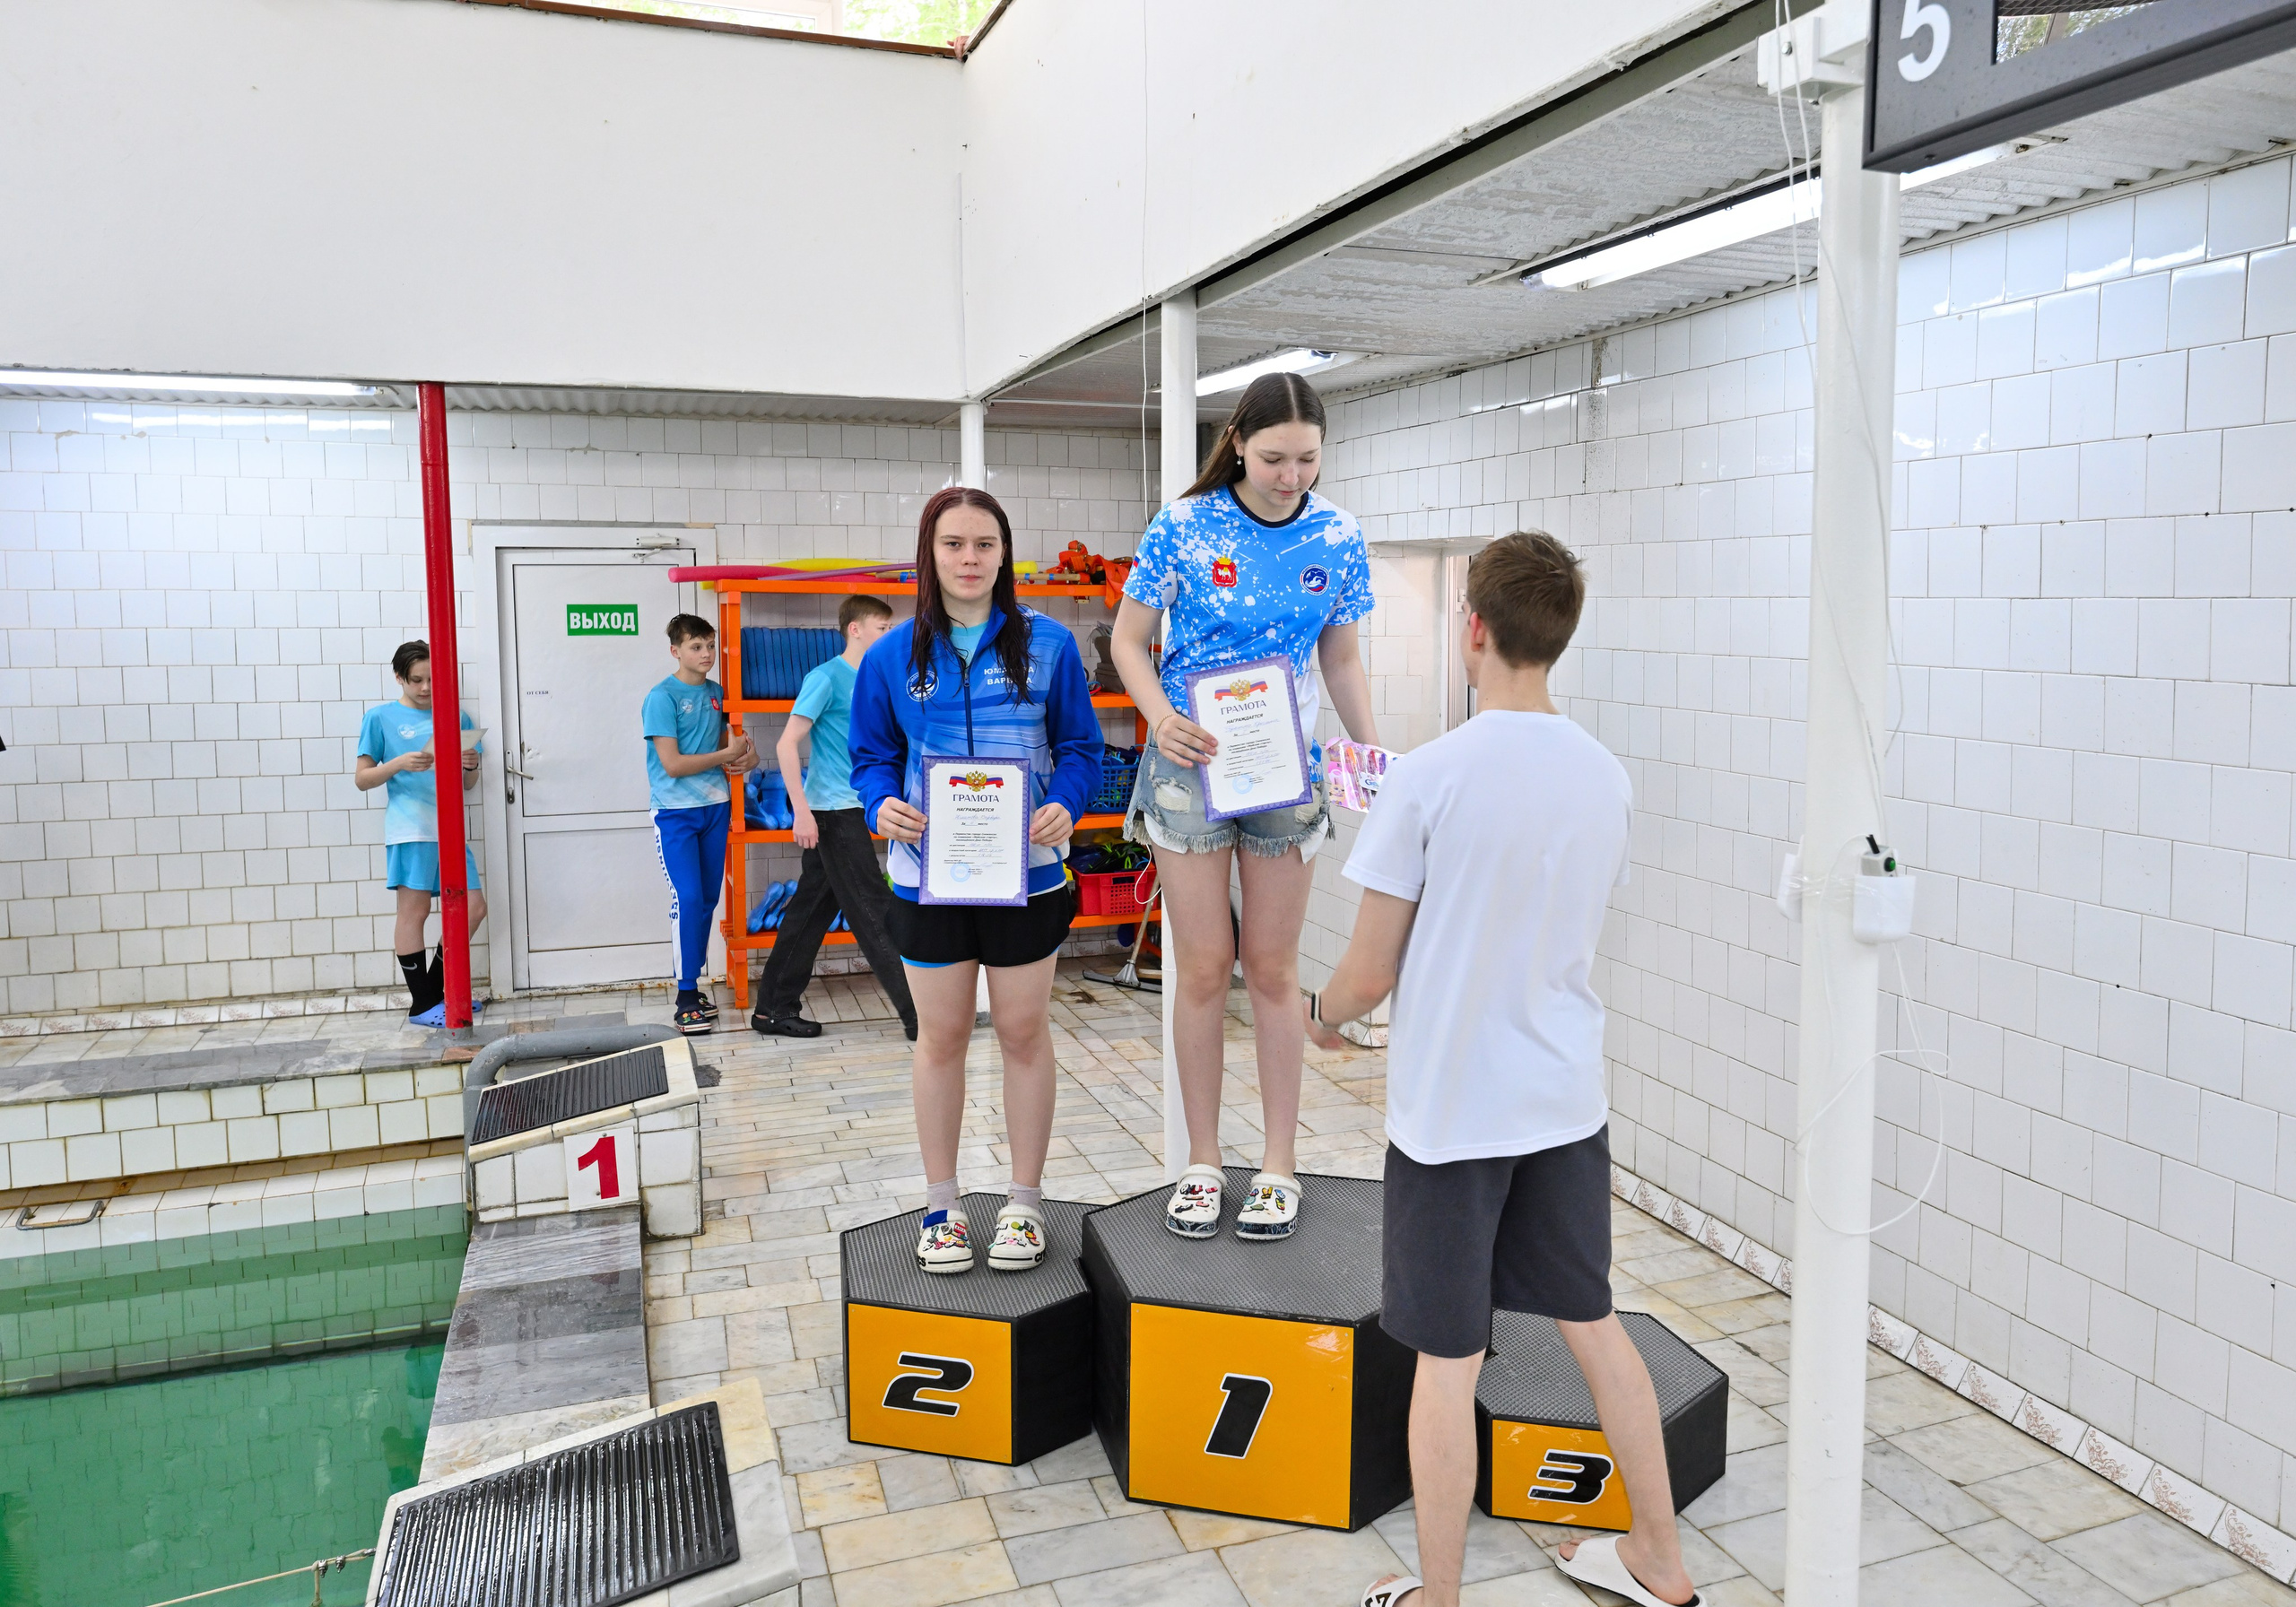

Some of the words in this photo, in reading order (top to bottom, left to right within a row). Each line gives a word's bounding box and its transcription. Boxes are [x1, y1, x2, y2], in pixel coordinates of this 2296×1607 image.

[1898, 0, 1951, 83] 5
[570, 612, 636, 632] ВЫХОД
[1221, 699, 1267, 716] ГРАМОТА
[1226, 713, 1264, 724] НАГРАЖДАЕТСЯ
[952, 794, 1000, 803] ГРАМОТА
[577, 1135, 620, 1200] 1
[881, 1351, 975, 1418] 2
[1204, 1372, 1274, 1460] 1
[1527, 1448, 1614, 1506] 3
